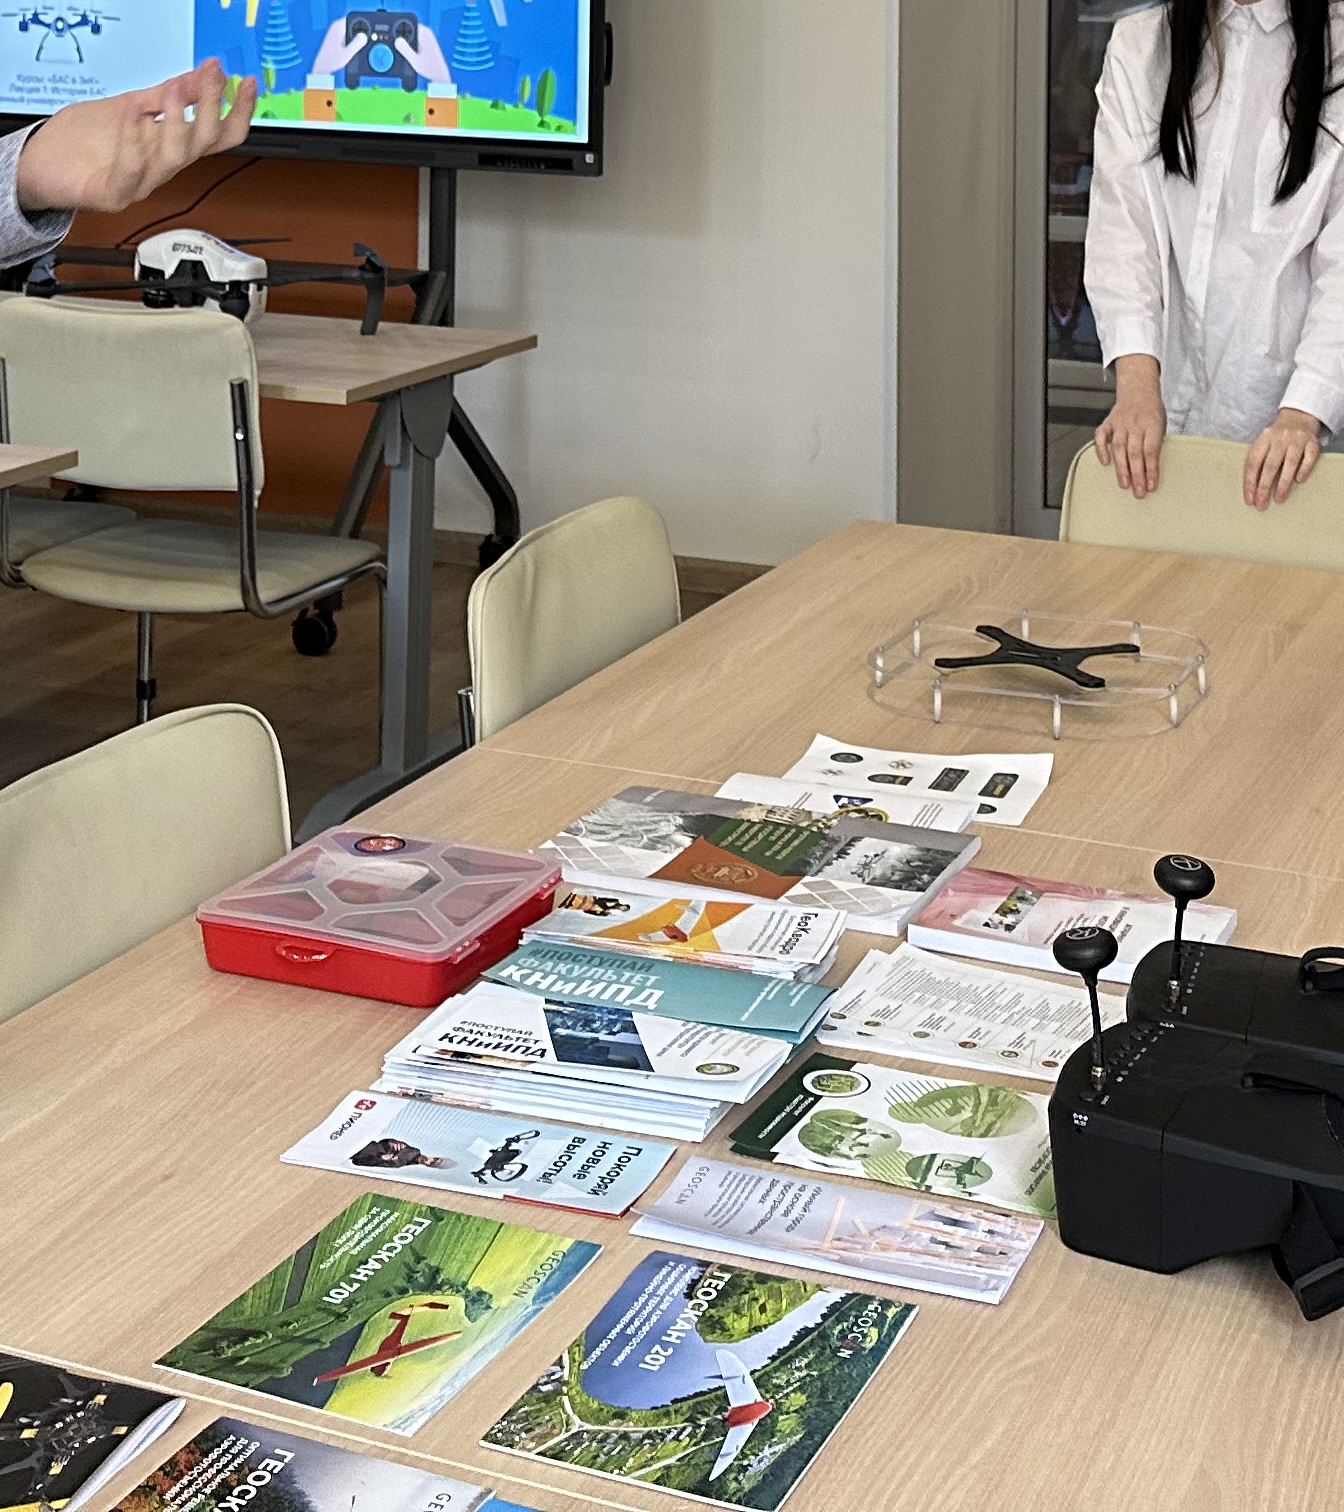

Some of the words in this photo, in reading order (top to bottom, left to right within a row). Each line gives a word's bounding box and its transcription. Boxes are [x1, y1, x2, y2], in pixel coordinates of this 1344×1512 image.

[498, 965, 665, 1010] КНиИПД
[518, 958, 661, 987] ФАКУЛЬТЕТ
[438, 1032, 547, 1058] КНиИПД
[453, 1026, 543, 1045] ФАКУЛЬТЕТ
[536, 1136, 587, 1184] высоты!
[577, 1141, 613, 1180] новые
[588, 1146, 642, 1197] Покоряй
[349, 1216, 432, 1284] ГЕОСКАН
[322, 1280, 360, 1304] 701
[513, 1249, 566, 1299] GEOSCAN
[623, 1296, 661, 1334] ТЕРРИТОРИЙ
[662, 1270, 732, 1345] ГЕОСКАН
[638, 1342, 674, 1372] 201
[229, 1437, 248, 1454] ДЛЯ
[163, 1434, 236, 1501] АЭРОФОТОСЪЕМКИ
[202, 1441, 260, 1494] ОПТИМАЛЬНОЕ
